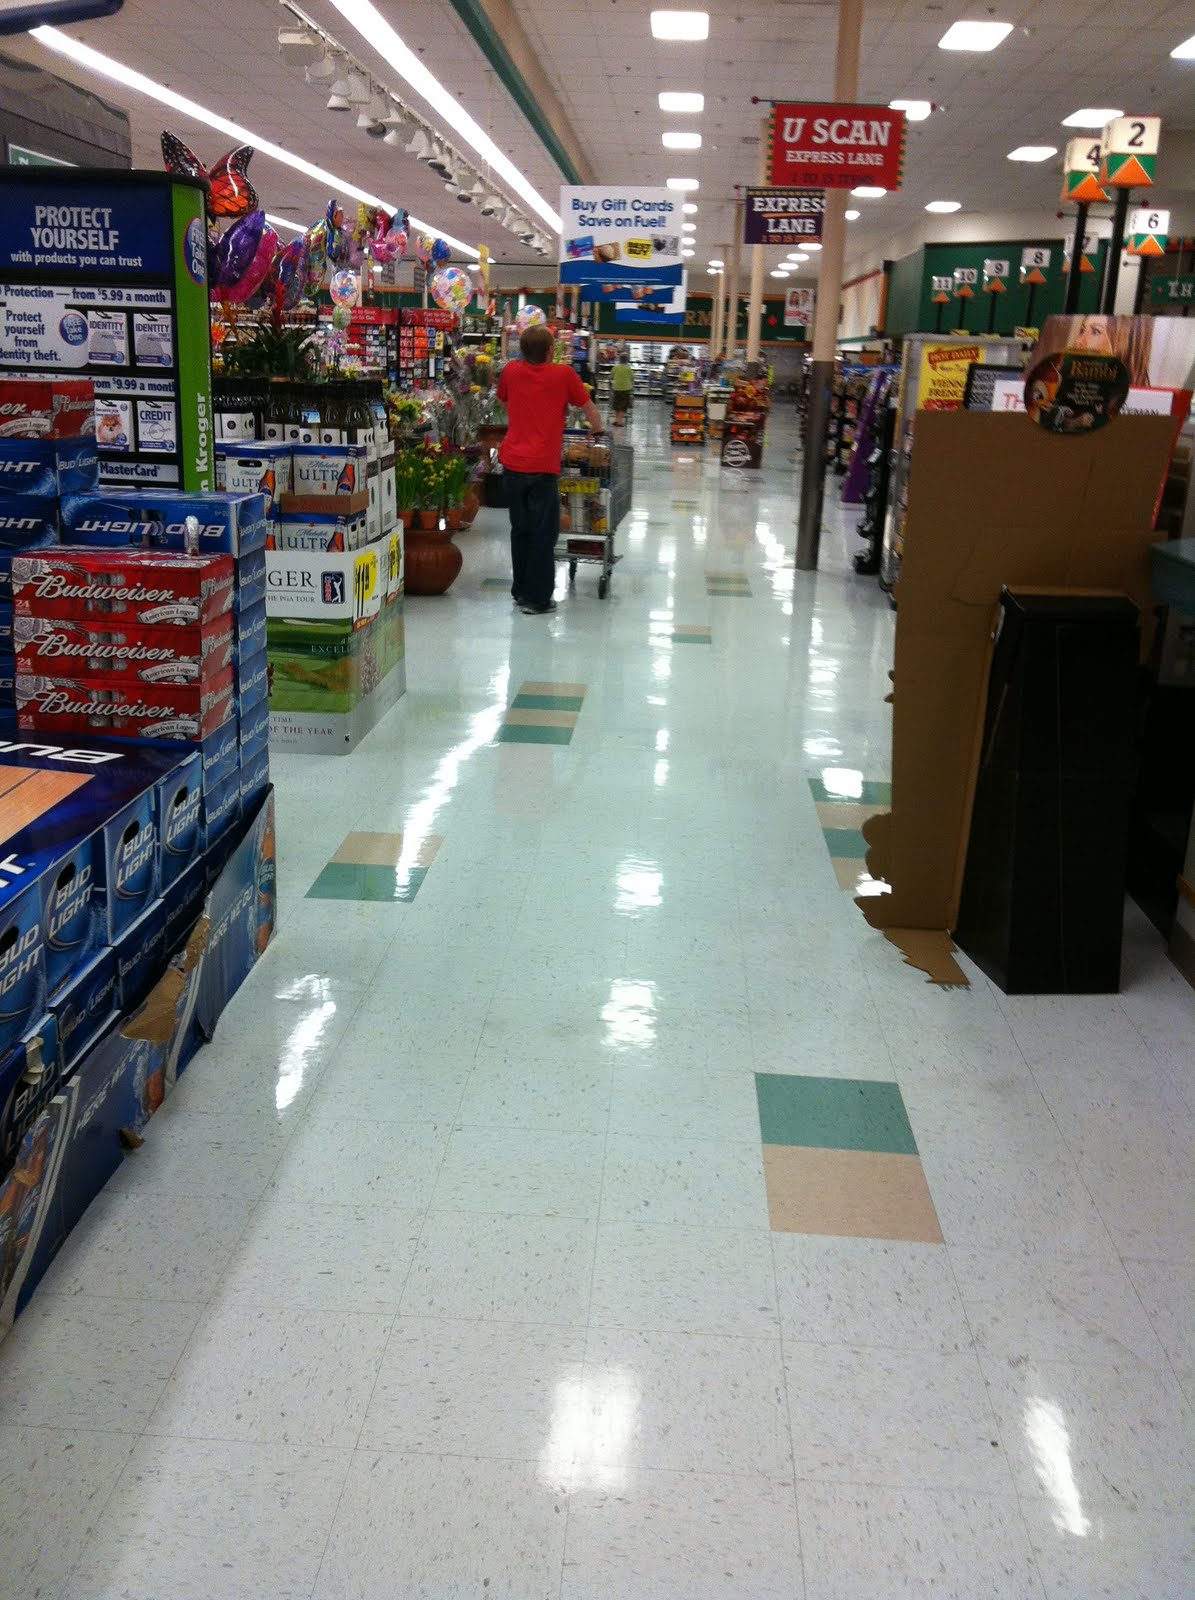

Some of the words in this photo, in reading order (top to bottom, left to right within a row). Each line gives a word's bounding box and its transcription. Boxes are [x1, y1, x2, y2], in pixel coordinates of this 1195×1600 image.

[783, 117, 807, 142] U
[812, 118, 891, 146] SCAN
[1128, 122, 1145, 147] 2
[786, 150, 844, 164] EXPRESS
[847, 152, 884, 166] LANE
[1087, 145, 1100, 166] 4
[572, 199, 598, 213] Buy
[602, 199, 627, 211] Gift
[631, 199, 674, 212] Cards
[35, 205, 112, 228] PROTECT
[578, 214, 612, 227] Save
[616, 218, 631, 227] on
[634, 216, 666, 228] Fuel!
[1147, 213, 1159, 229] 6
[767, 219, 816, 233] LANE
[30, 228, 119, 250] YOURSELF
[11, 250, 33, 263] with
[35, 252, 77, 266] products
[79, 256, 97, 267] you
[99, 257, 116, 266] can
[119, 256, 142, 267] trust
[628, 248, 648, 256] BUY
[1034, 251, 1043, 264] 8
[960, 270, 974, 281] 10
[995, 263, 1003, 275] 9
[4, 286, 54, 298] Protection
[72, 288, 95, 300] from
[97, 288, 123, 300] $5.99
[126, 293, 131, 301] a
[135, 291, 166, 303] month
[6, 310, 42, 322] Protect
[63, 318, 81, 328] FREE
[5, 324, 45, 336] yourself
[66, 325, 82, 334] Take
[90, 321, 123, 330] IDENTITY
[136, 324, 169, 332] IDENTITY
[14, 337, 38, 348] from
[67, 333, 82, 341] One
[34, 350, 61, 361] theft.
[93, 381, 110, 389] rom
[112, 378, 136, 390] $9.99
[140, 410, 172, 421] CREDIT
[196, 393, 209, 472] Kroger
[58, 460, 76, 471] BUD
[78, 456, 99, 467] LIGHT
[100, 463, 158, 477] MasterCard
[268, 570, 315, 588] GER
[29, 574, 174, 602] Budweiser
[16, 600, 30, 609] 24
[31, 633, 175, 661] Budweiser
[17, 658, 31, 666] 24
[34, 691, 175, 719] Budweiser
[19, 715, 33, 723] 24
[308, 728, 334, 736] YEAR
[173, 787, 200, 819] BUD
[166, 803, 201, 843] LIGHT
[123, 822, 152, 862] BUD
[117, 838, 155, 888] LIGHT
[56, 865, 91, 910] BUD
[49, 882, 94, 939] LIGHT
